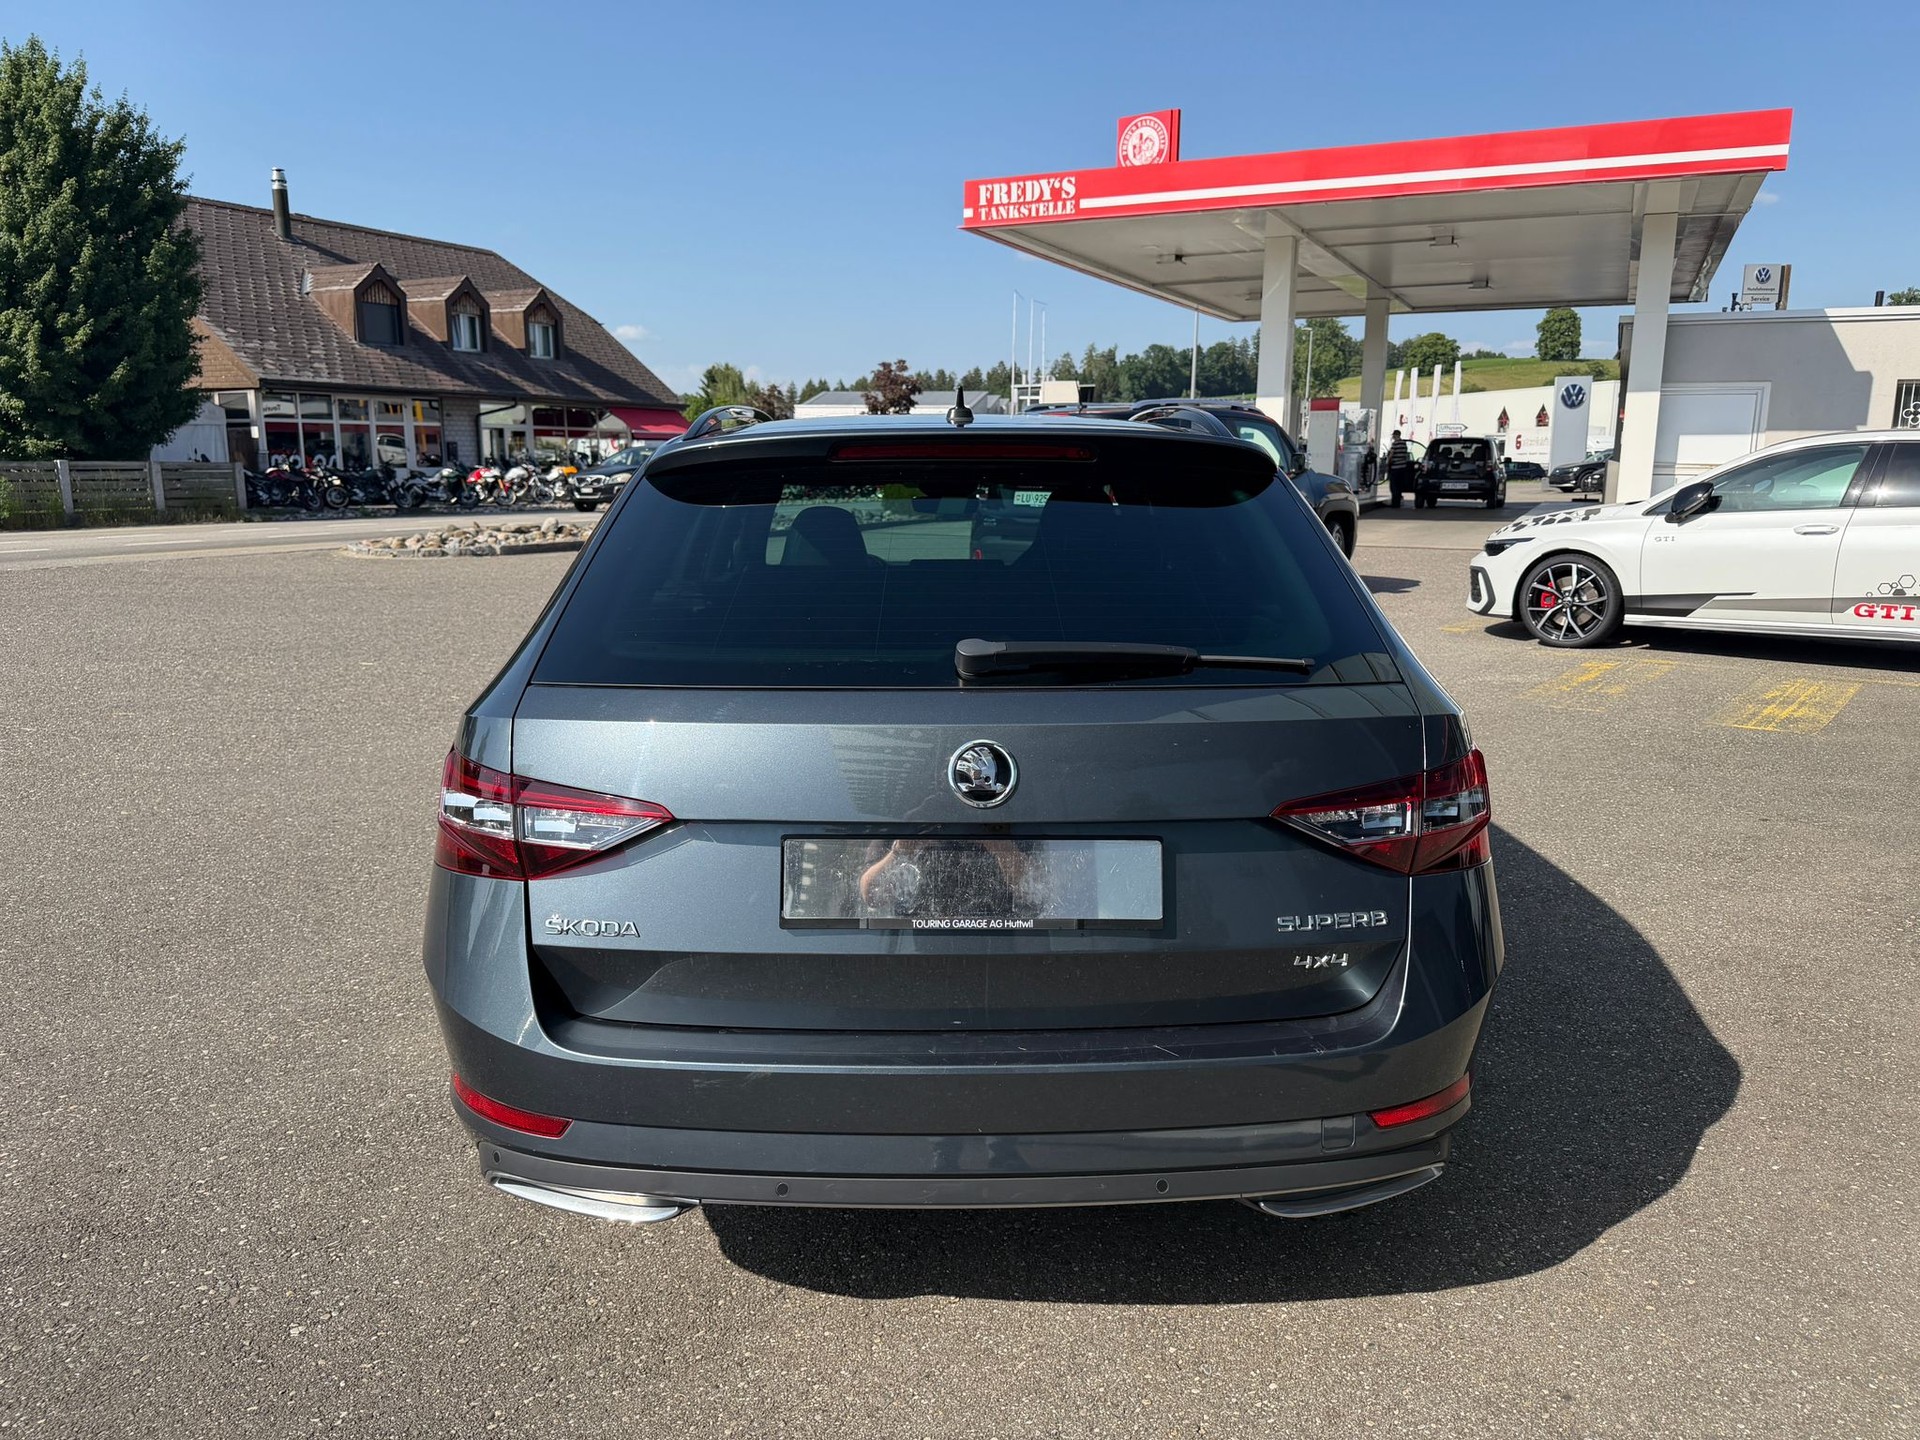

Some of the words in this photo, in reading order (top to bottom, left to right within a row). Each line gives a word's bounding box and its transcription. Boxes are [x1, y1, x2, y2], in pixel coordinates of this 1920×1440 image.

[979, 177, 1076, 205] FREDY'S
[979, 200, 1076, 221] TANKSTELLE
[1853, 603, 1916, 621] GTI
[545, 914, 640, 937] ŠKODA
[912, 919, 950, 928] TOURING
[952, 919, 987, 928] GARAGE
[989, 919, 1002, 928] AG
[1004, 919, 1034, 928] Huttwil
[1277, 910, 1388, 932] SUPERB
[1293, 952, 1349, 969] 4x4
